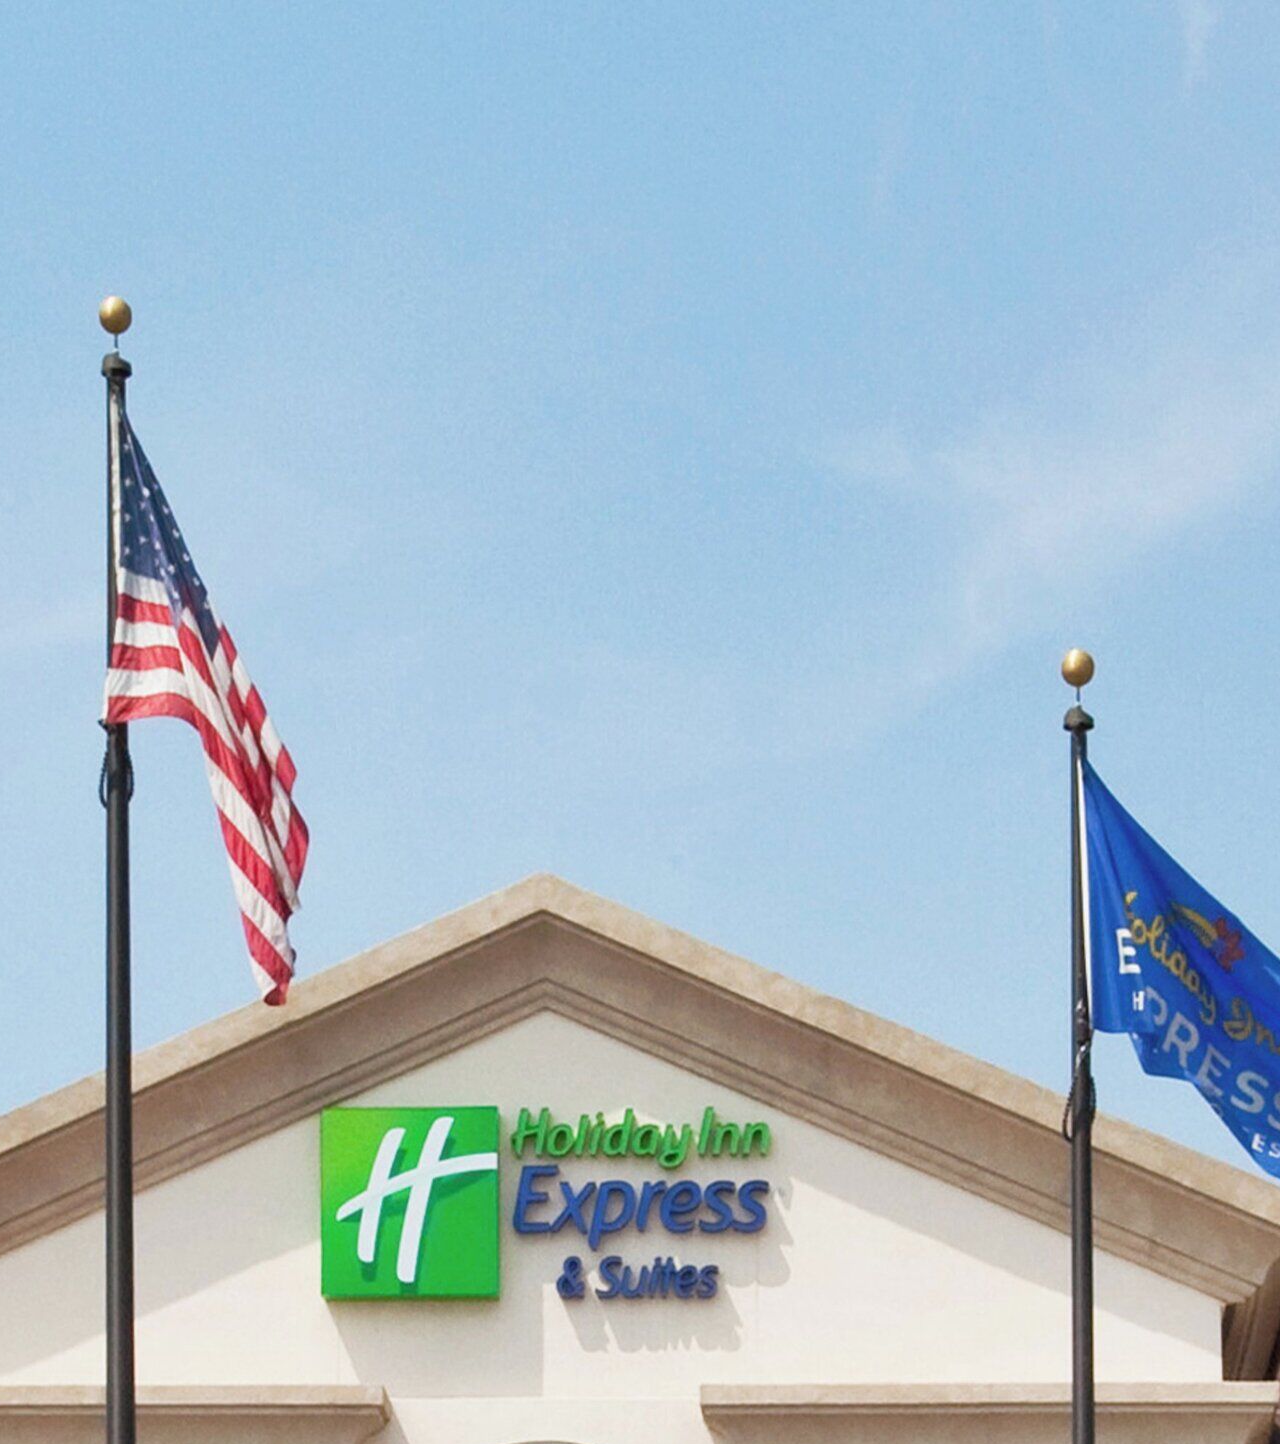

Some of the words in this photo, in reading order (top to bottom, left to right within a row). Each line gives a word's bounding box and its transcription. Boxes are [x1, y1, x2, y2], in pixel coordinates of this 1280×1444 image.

[511, 1107, 693, 1169] Holiday
[697, 1106, 771, 1158] Inn
[512, 1164, 770, 1252] Express
[556, 1255, 585, 1299] &
[595, 1255, 719, 1299] Suites
